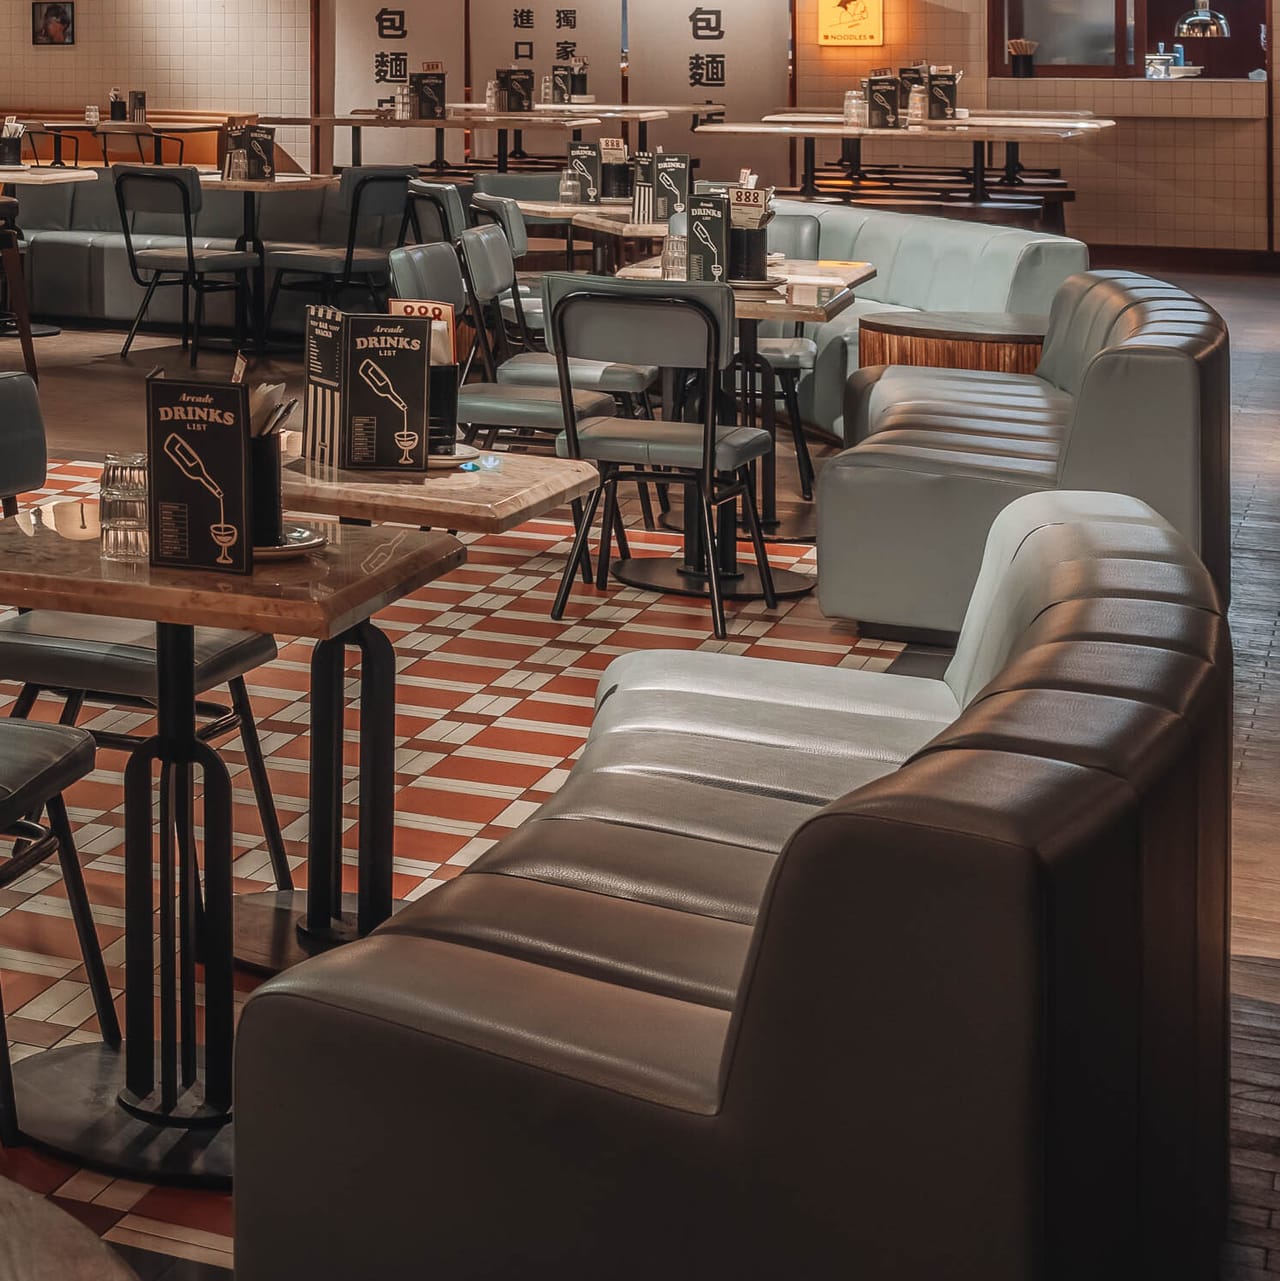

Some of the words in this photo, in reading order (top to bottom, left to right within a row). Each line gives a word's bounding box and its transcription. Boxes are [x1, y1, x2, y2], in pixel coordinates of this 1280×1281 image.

[513, 9, 534, 60] 進口
[556, 9, 577, 60] 獨家
[604, 139, 621, 148] 888
[571, 149, 596, 158] DRINKS
[658, 161, 686, 170] DRINKS
[735, 190, 760, 204] 888
[691, 208, 722, 219] DRINKS
[372, 324, 405, 334] Arcade
[355, 336, 422, 351] DRINKS
[178, 392, 215, 404] Arcade
[158, 406, 236, 427] DRINKS
[186, 423, 209, 432] LIST
